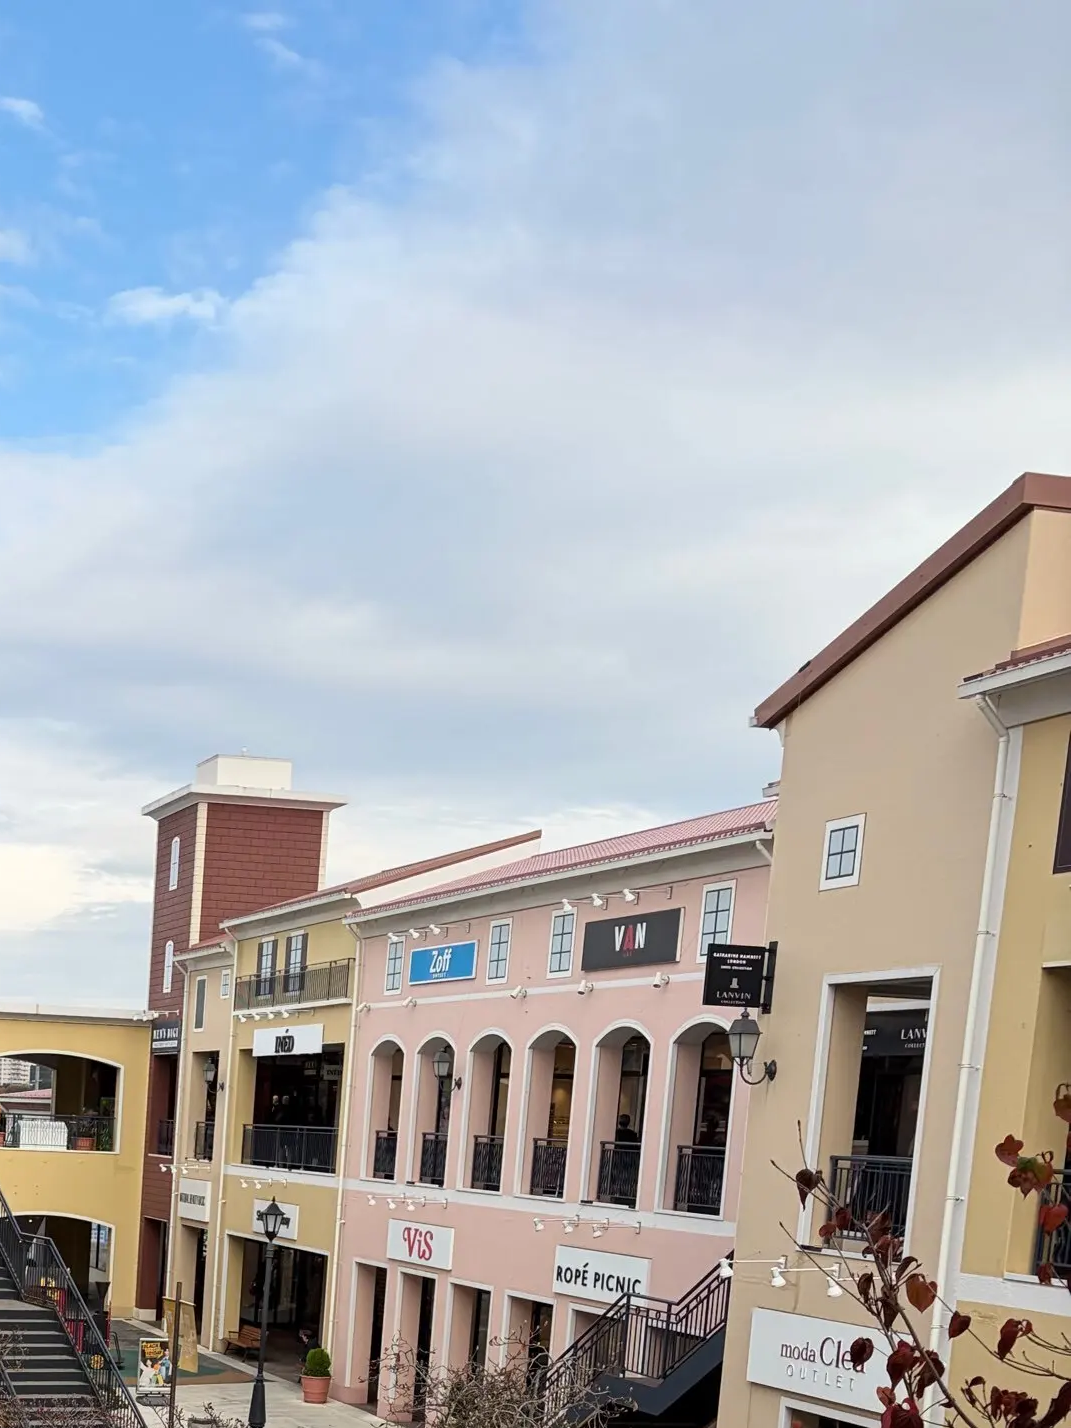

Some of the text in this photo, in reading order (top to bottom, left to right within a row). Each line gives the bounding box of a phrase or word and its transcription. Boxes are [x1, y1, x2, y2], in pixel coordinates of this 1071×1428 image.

[614, 922, 647, 952] VAN
[430, 947, 452, 973] Zoff
[716, 991, 751, 1000] LANVIN
[556, 1262, 642, 1295] ROPÉ PICNIC
[780, 1341, 816, 1364] moda
[786, 1364, 856, 1392] OUTLET
